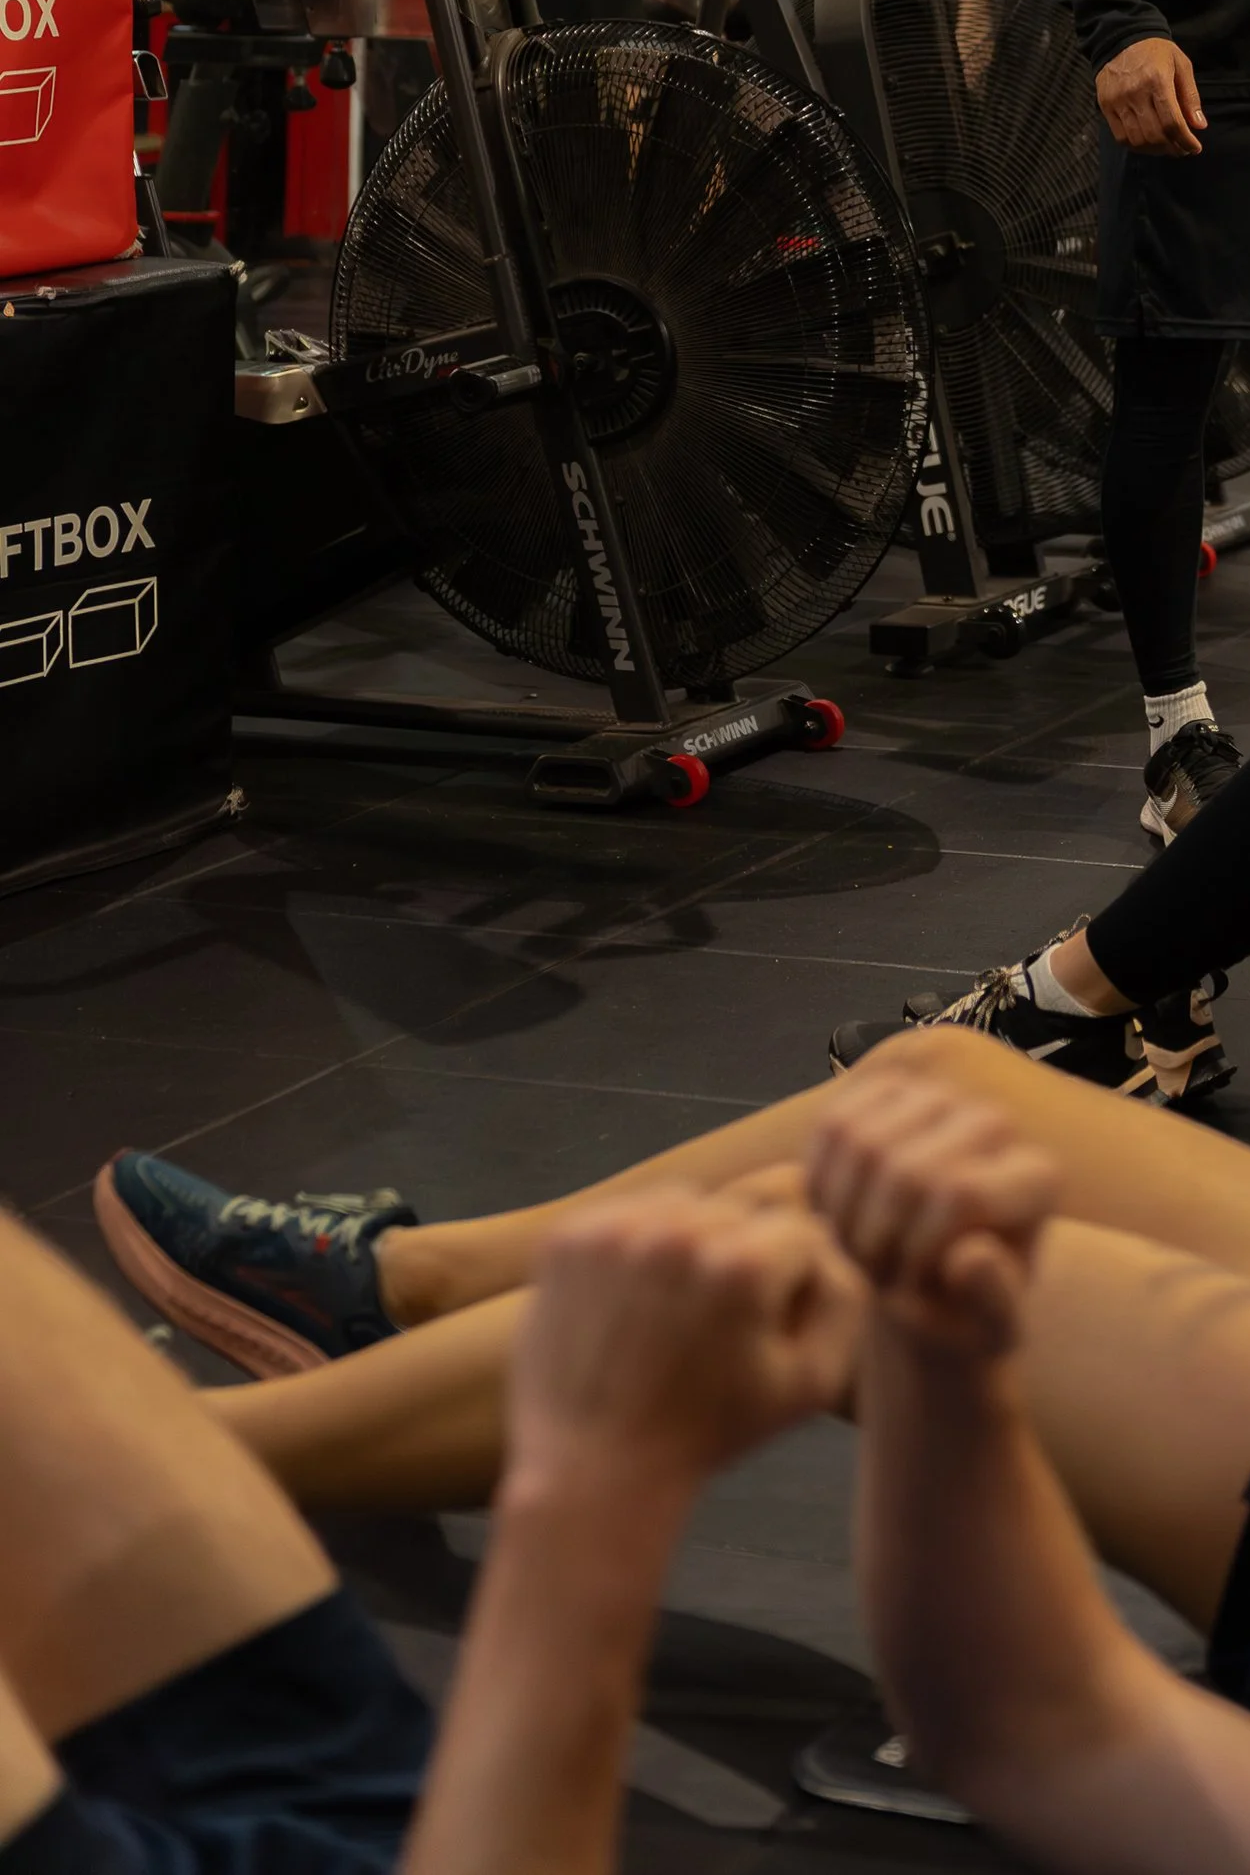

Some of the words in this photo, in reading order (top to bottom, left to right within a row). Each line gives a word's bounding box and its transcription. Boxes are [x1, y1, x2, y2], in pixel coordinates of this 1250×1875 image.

[0, 498, 156, 579] FTBOX
[561, 461, 635, 672] SCHWINN
[683, 714, 760, 757] SCHWINN
